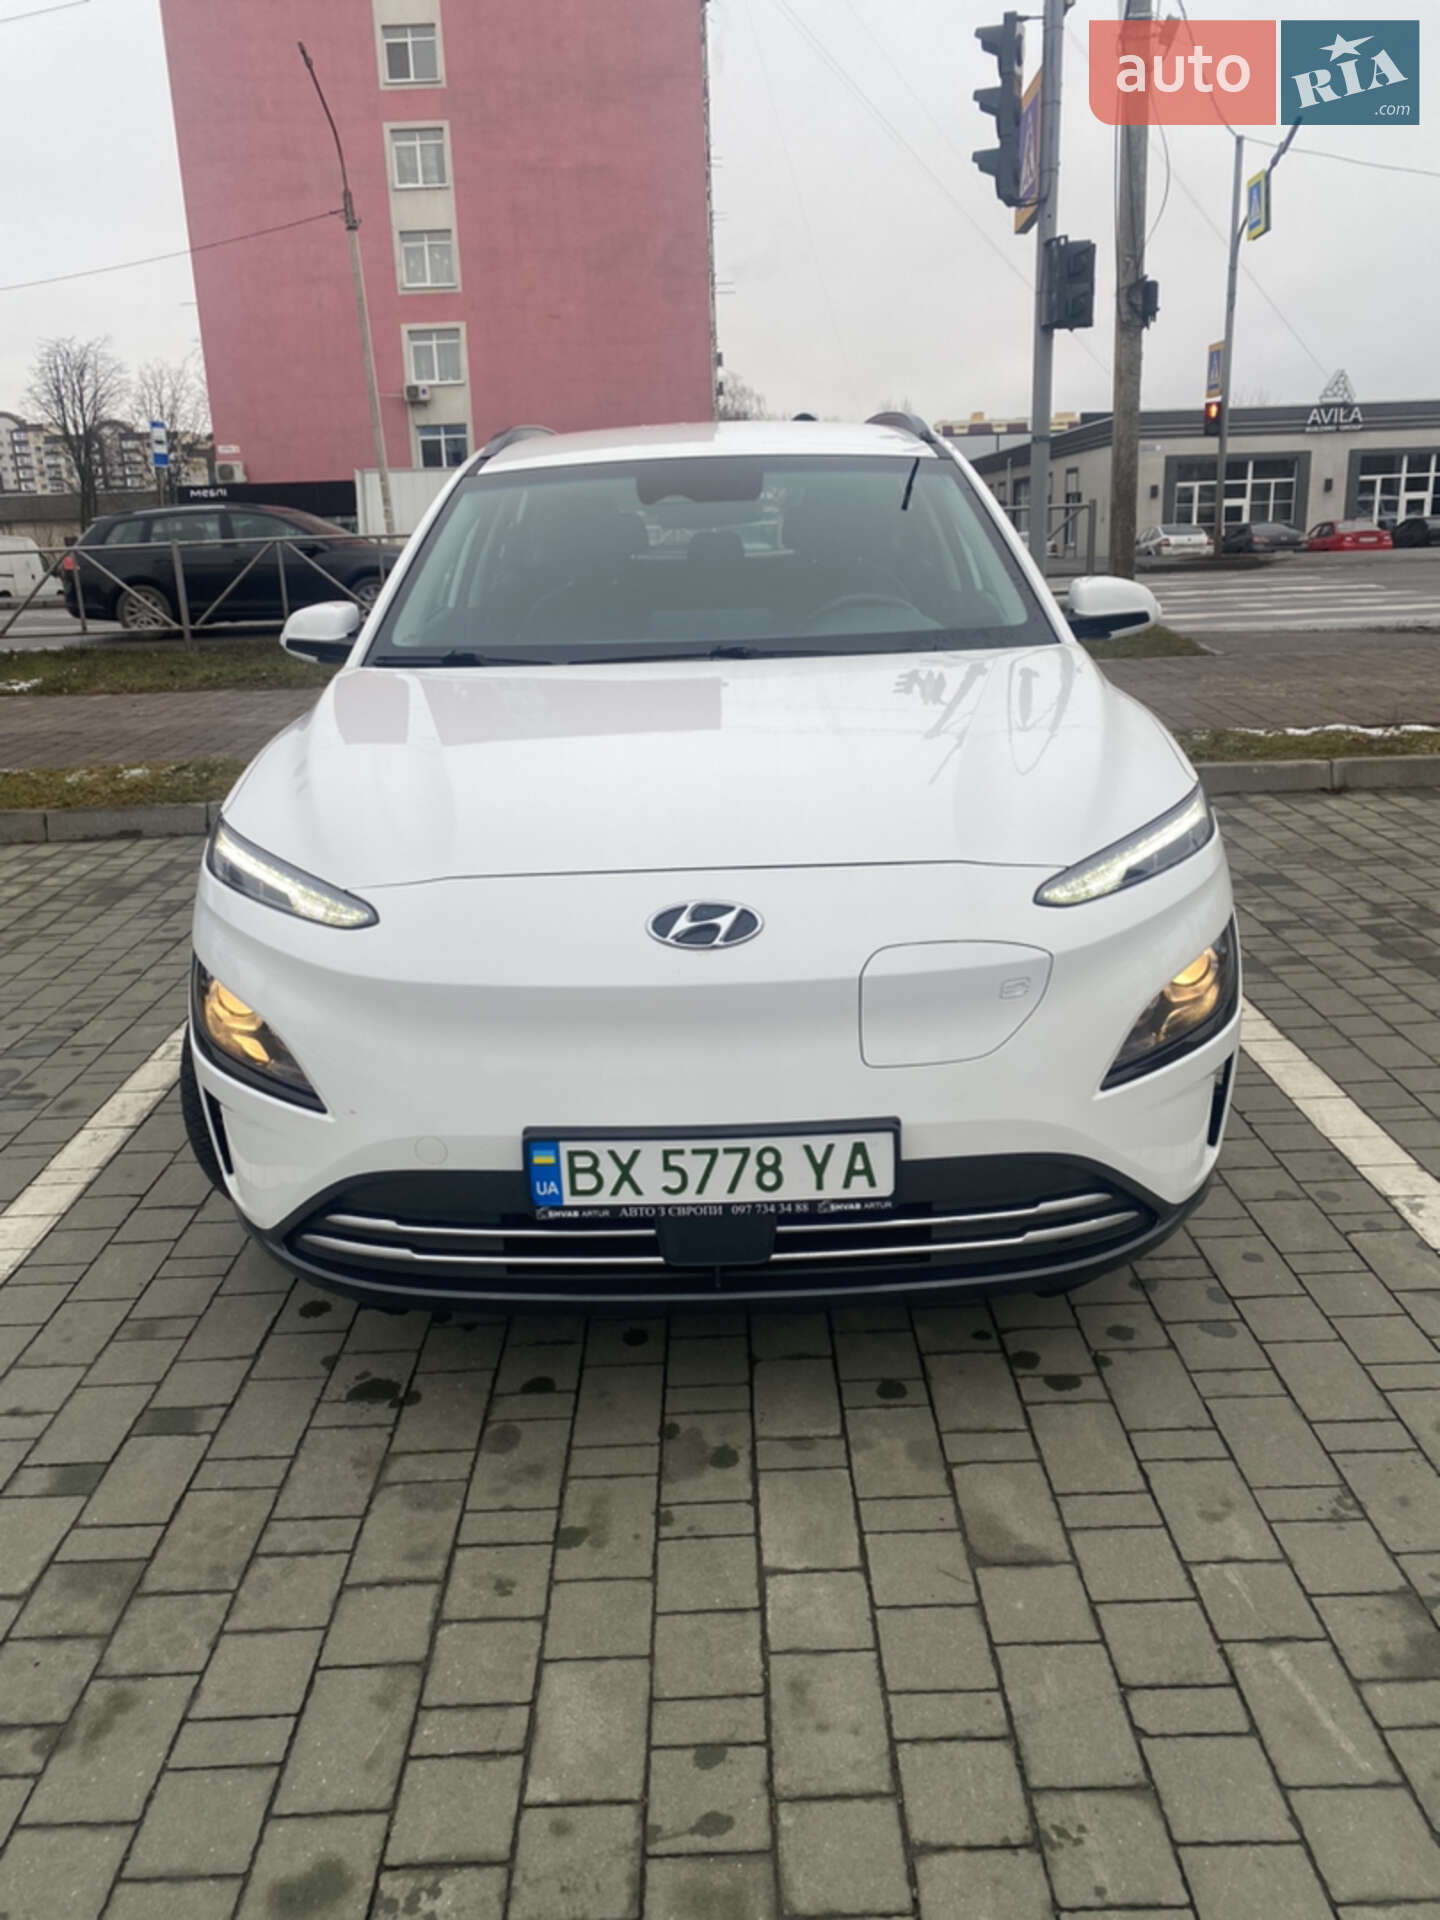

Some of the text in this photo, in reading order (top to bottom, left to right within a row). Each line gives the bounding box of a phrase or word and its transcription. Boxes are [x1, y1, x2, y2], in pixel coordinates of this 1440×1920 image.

[566, 1141, 877, 1197] BX 5778 YA
[535, 1181, 559, 1196] UA
